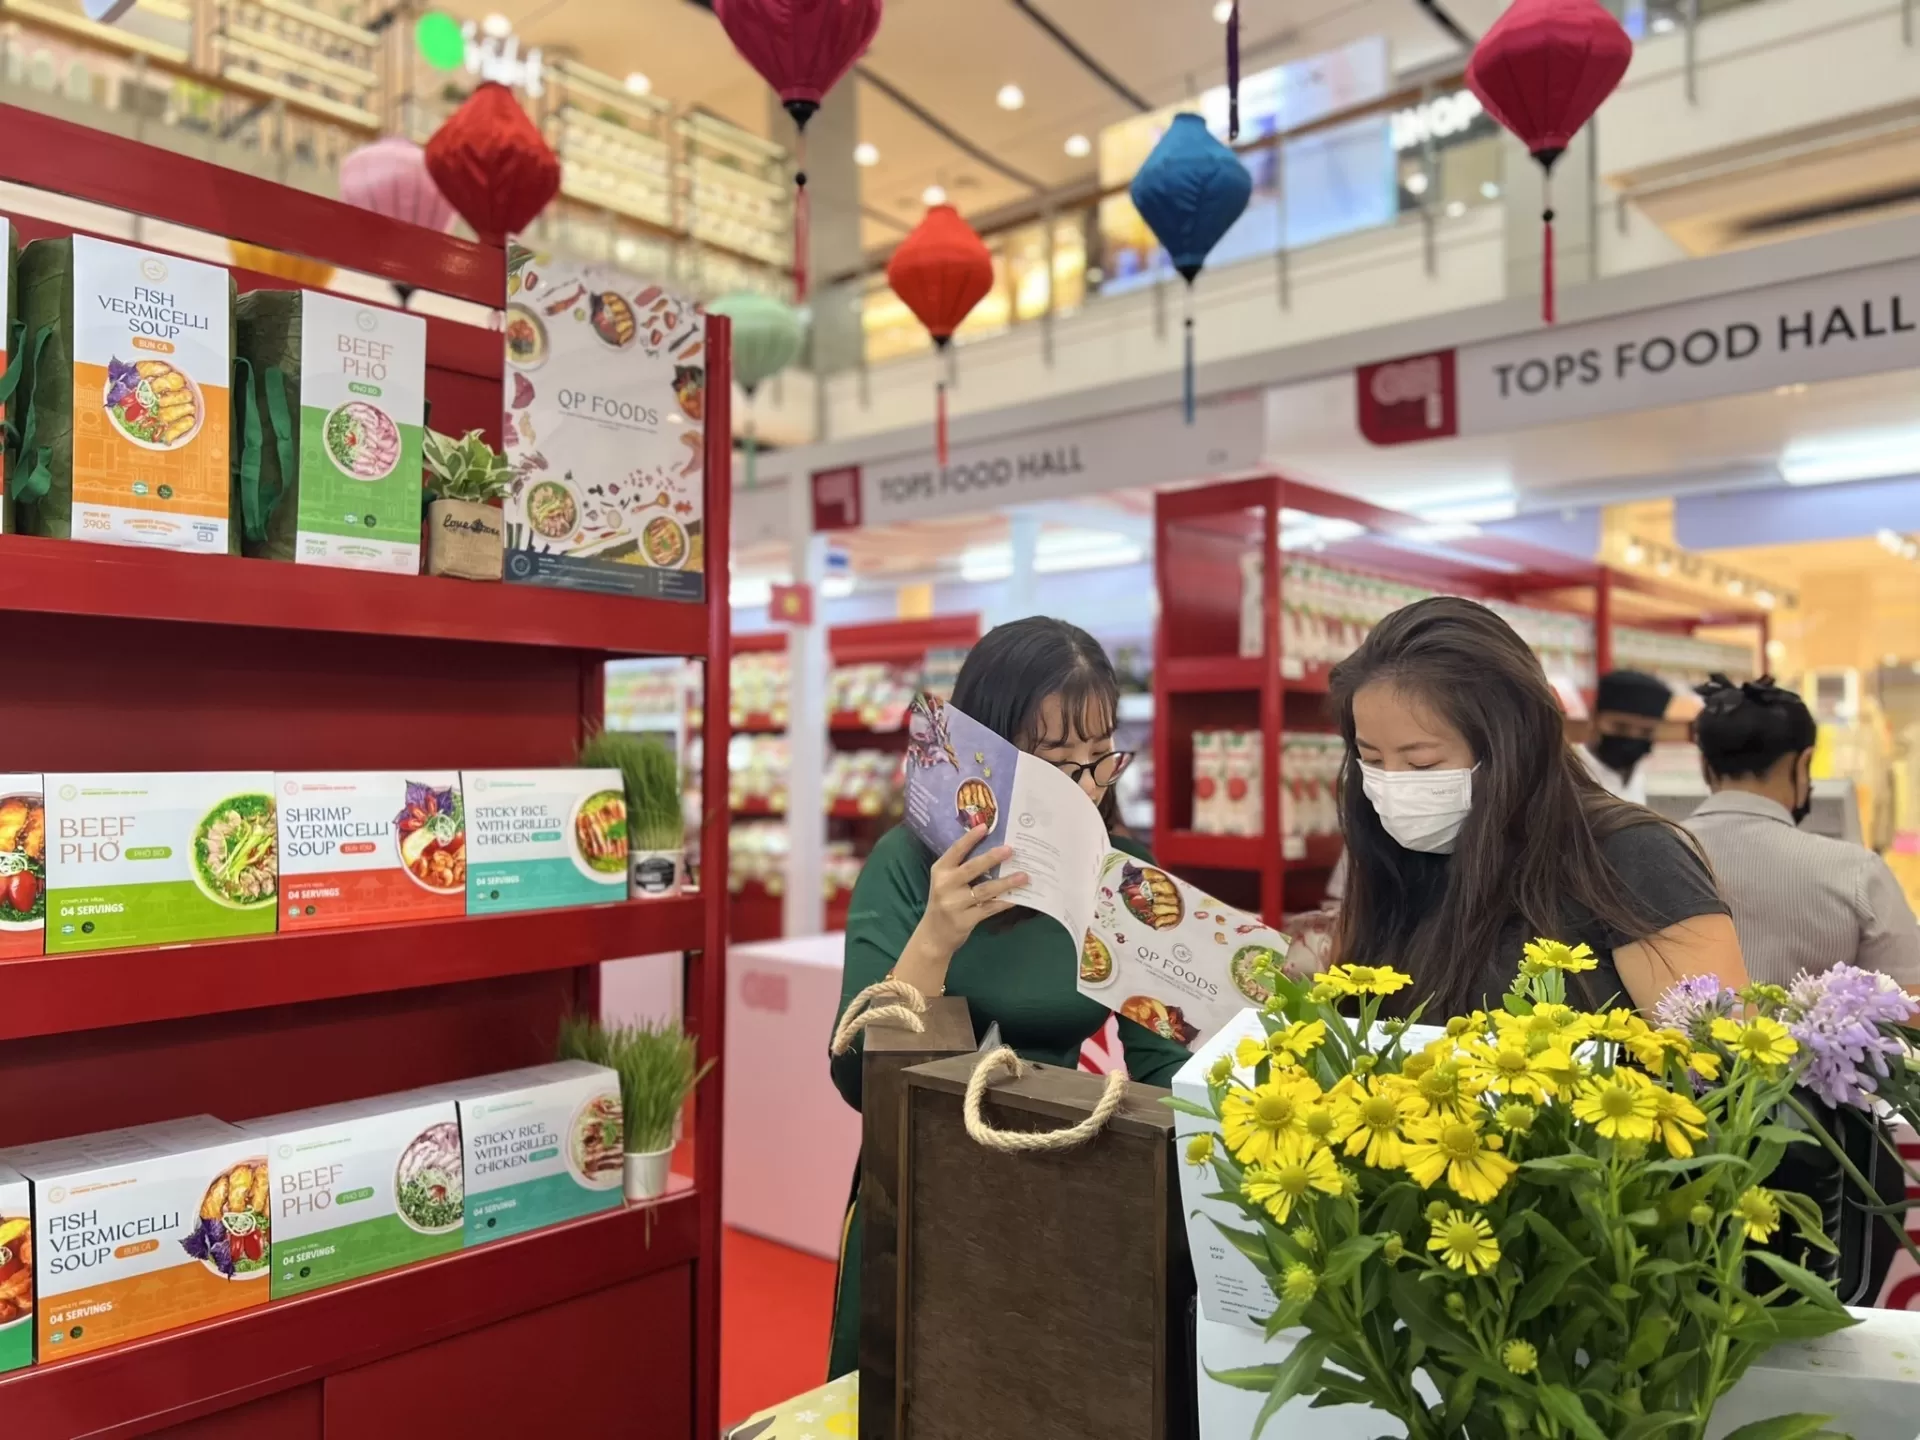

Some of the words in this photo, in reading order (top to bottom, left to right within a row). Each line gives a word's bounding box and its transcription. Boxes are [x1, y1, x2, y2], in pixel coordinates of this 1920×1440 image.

[134, 286, 174, 307] FISH
[98, 295, 208, 330] VERMICELLI
[128, 318, 180, 339] SOUP
[337, 334, 394, 361] BEEF
[1493, 348, 1602, 397] TOPS
[1615, 322, 1760, 379] FOOD
[1777, 295, 1915, 352] HALL
[558, 388, 586, 410] QP
[592, 395, 658, 425] FOODS
[879, 471, 935, 503] TOPS
[1017, 445, 1085, 480] HALL
[83, 519, 111, 531] 390G
[285, 806, 352, 822] SHRIMP
[475, 806, 518, 818] STICKY
[521, 805, 548, 817] RICE
[59, 816, 136, 838] BEEF
[287, 821, 389, 839] VERMICELLI
[476, 821, 510, 832] WITH
[513, 818, 561, 829] GRILLED
[287, 840, 336, 857] SOUP
[477, 832, 530, 846] CHICKEN
[487, 875, 520, 885] SERVINGS
[288, 891, 299, 900] 04
[301, 888, 340, 899] SERVINGS
[60, 906, 74, 917] 04
[77, 903, 124, 916] SERVINGS
[1137, 946, 1160, 962] QP
[1162, 959, 1218, 995] FOODS
[473, 1129, 516, 1148] STICKY
[518, 1122, 546, 1138] RICE
[474, 1144, 508, 1161] WITH
[510, 1133, 558, 1153] GRILLED
[474, 1154, 527, 1175] CHICKEN
[281, 1163, 343, 1194] BEEF
[49, 1209, 97, 1234] FISH
[50, 1211, 179, 1253] VERMICELLI
[50, 1247, 111, 1274] SOUP
[283, 1255, 294, 1266] 04
[296, 1245, 335, 1263] SERVINGS
[49, 1313, 64, 1325] 04
[65, 1301, 112, 1321] SERVINGS
